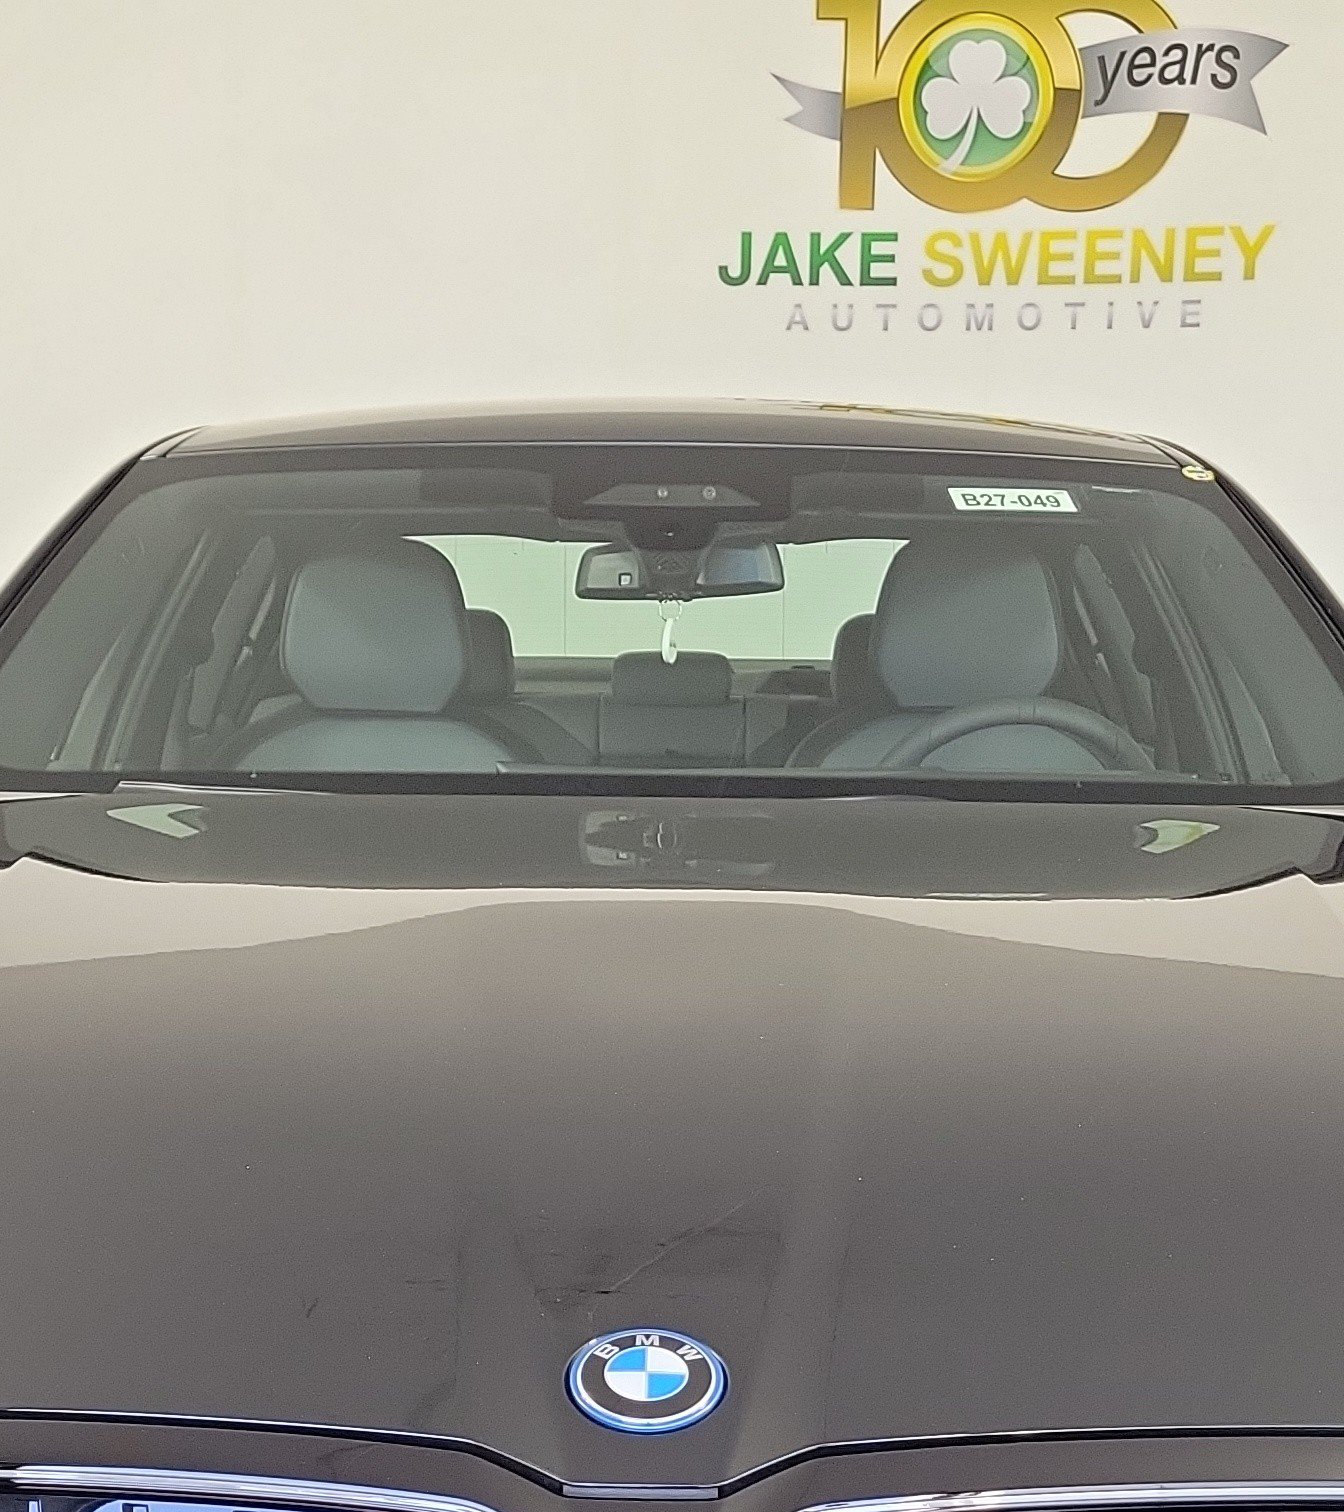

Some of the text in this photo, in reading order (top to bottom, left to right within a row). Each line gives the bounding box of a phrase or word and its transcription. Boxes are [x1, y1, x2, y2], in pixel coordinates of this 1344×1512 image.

[816, 0, 1241, 212] 100 years
[717, 223, 1276, 287] JAKE SWEENEY
[785, 299, 1202, 333] AUTOMOTIVE
[960, 492, 1062, 509] B27-049
[593, 1334, 703, 1361] BMW
